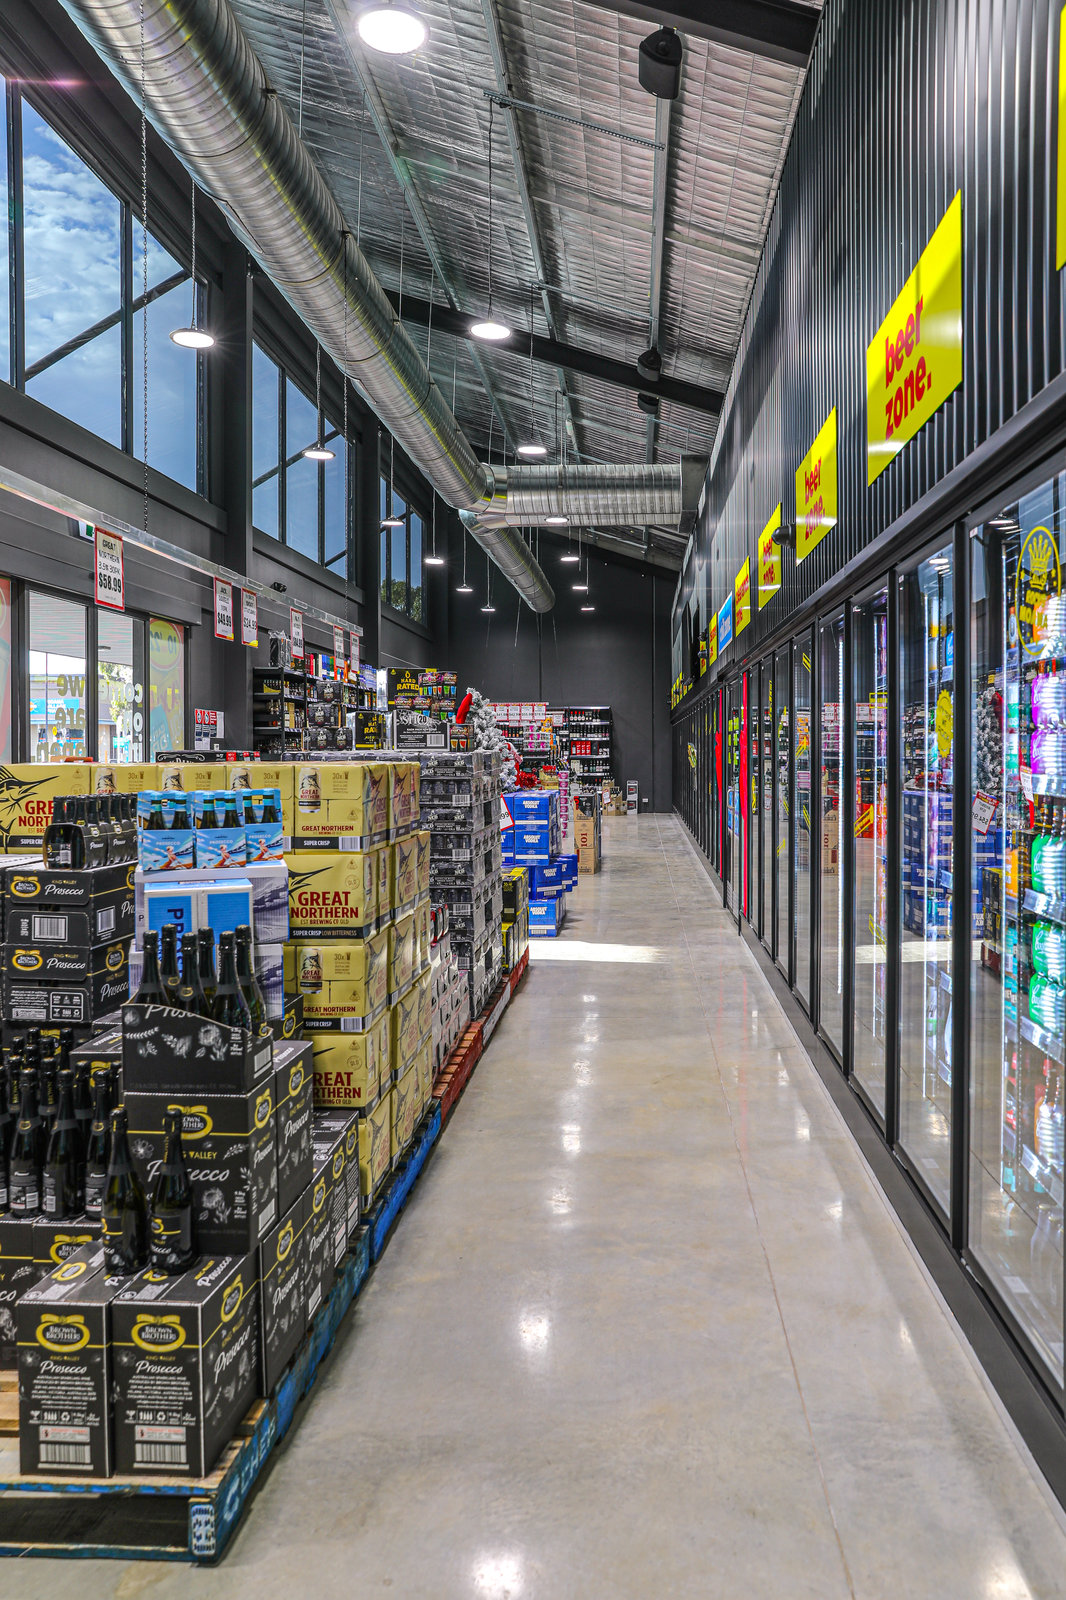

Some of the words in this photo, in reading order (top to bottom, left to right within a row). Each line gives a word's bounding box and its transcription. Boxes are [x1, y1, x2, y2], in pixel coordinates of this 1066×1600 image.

[885, 294, 923, 389] beer
[885, 356, 932, 441] zone.
[805, 456, 821, 504] beer
[805, 495, 825, 541] zone.
[102, 540, 116, 550] GREAT
[99, 572, 122, 593] $58.99
[25, 800, 53, 815] GRE
[19, 816, 52, 827] NORT
[45, 884, 84, 896] Prosecco
[298, 891, 350, 906] GREAT
[291, 907, 359, 918] NORTHERN
[47, 958, 85, 969] Prosecco
[313, 1072, 353, 1086] REAT
[313, 1088, 361, 1098] RTHERN
[285, 1110, 309, 1144] Prosecco
[189, 1151, 217, 1159] VALLEY
[310, 1221, 330, 1260] Prosecco
[197, 1257, 232, 1286] Prosecco
[273, 1267, 299, 1315] Prosecco
[214, 1325, 250, 1384] Prosecco
[40, 1360, 87, 1374] Prosecco
[136, 1360, 183, 1374] Prosecco
